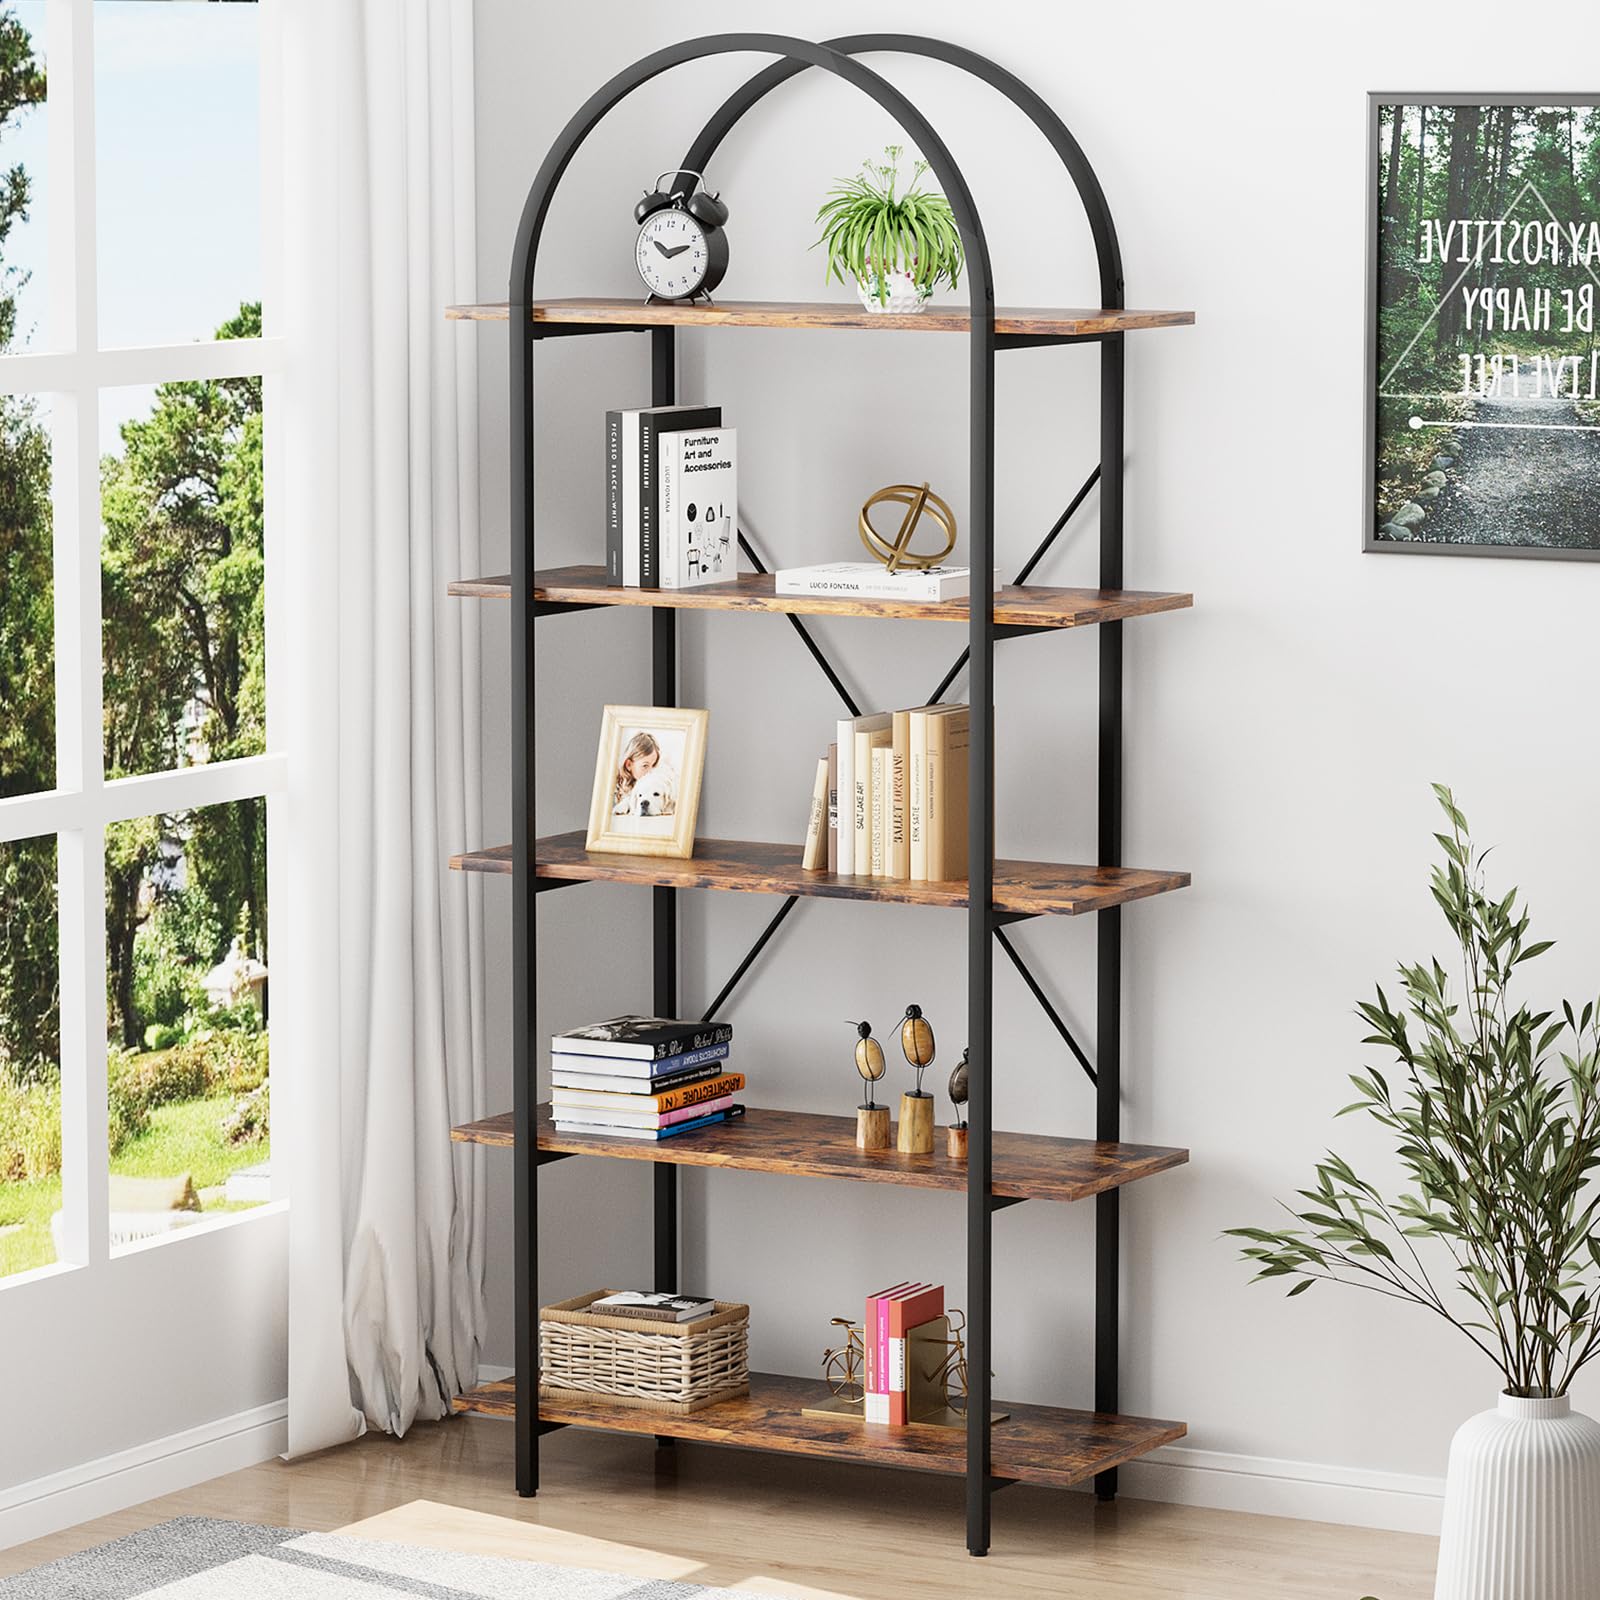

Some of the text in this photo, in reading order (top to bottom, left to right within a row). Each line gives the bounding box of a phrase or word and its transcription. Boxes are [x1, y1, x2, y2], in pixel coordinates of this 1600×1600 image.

[684, 436, 719, 447] Furniture
[684, 449, 712, 460] Art and
[684, 460, 732, 473] Accessories
[893, 754, 903, 803] LORRAINE
[683, 1078, 740, 1103] ARCHITECTURE
